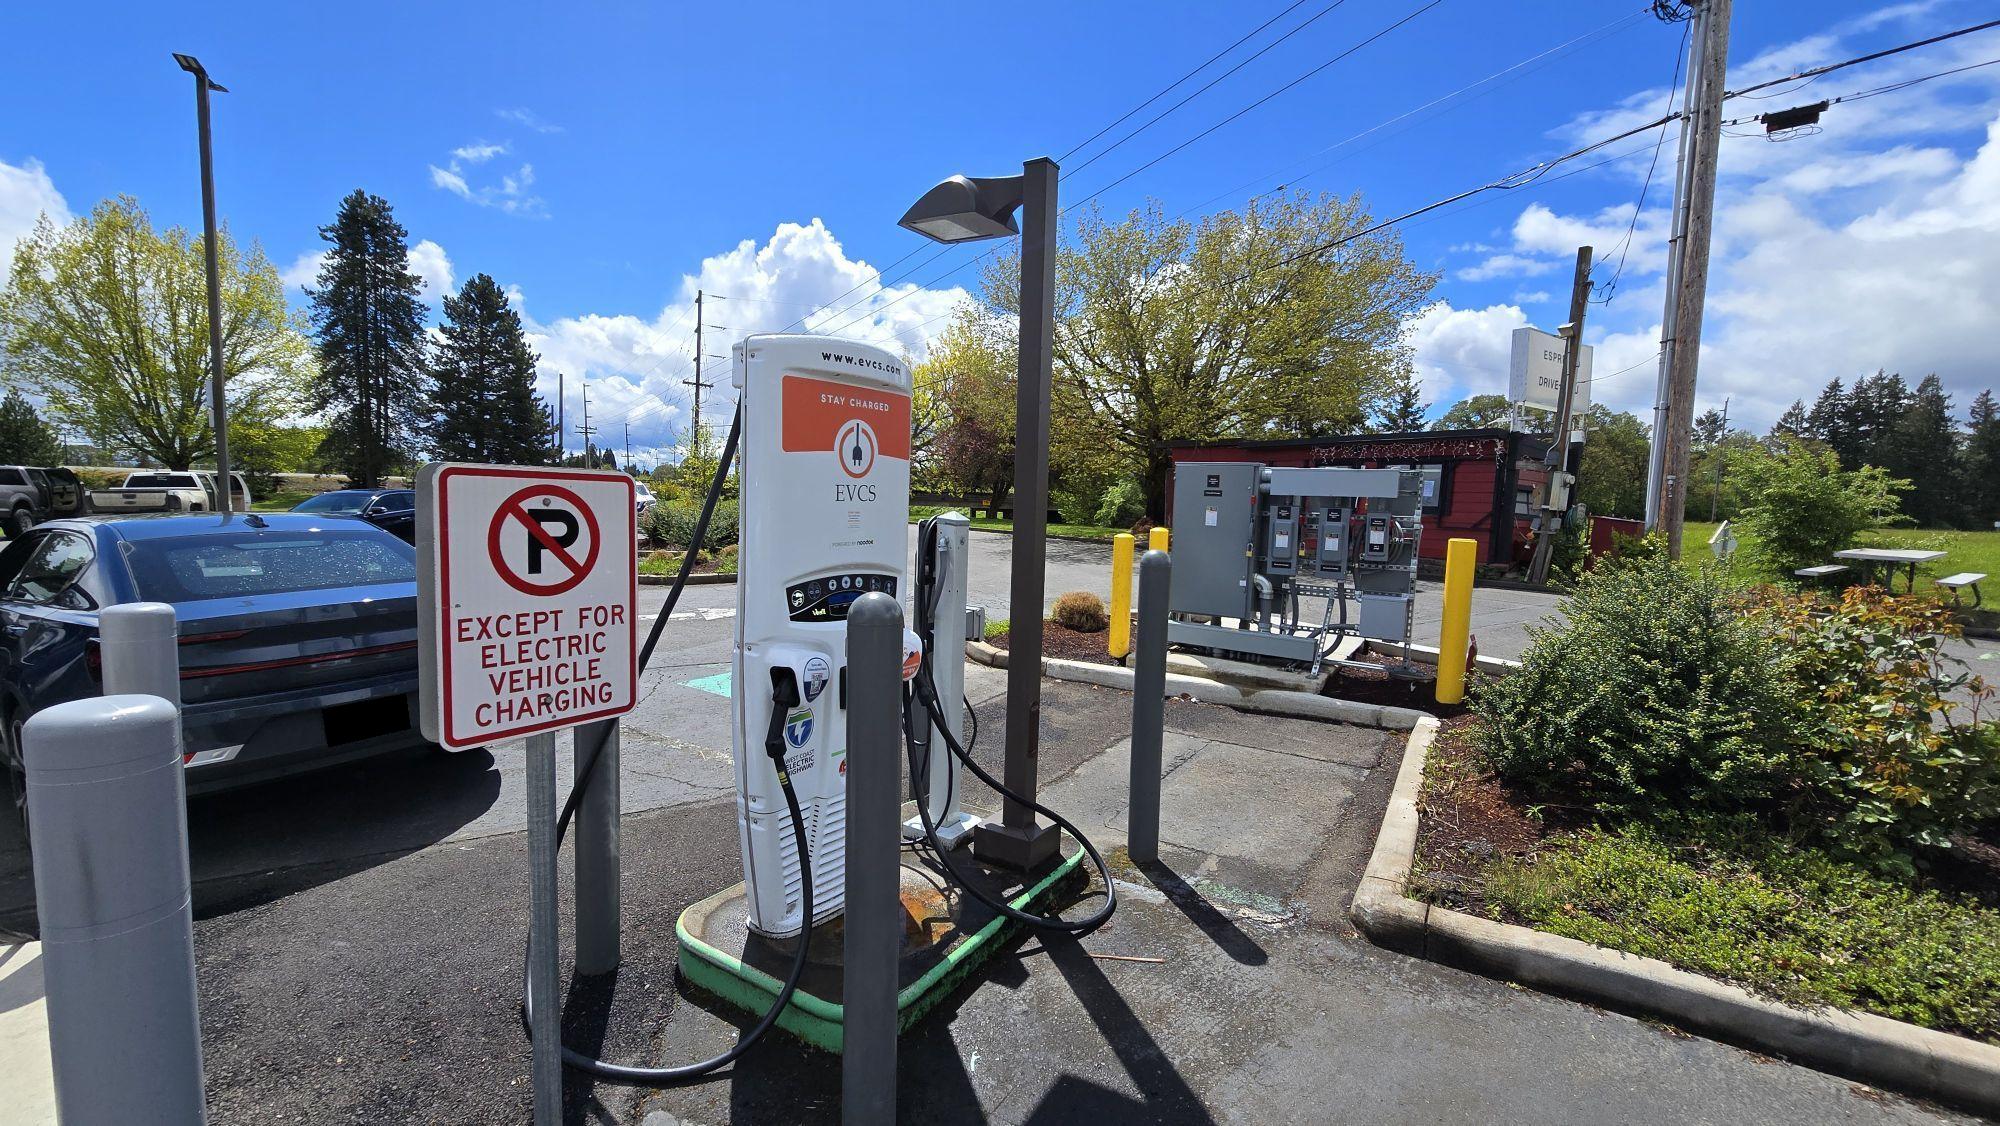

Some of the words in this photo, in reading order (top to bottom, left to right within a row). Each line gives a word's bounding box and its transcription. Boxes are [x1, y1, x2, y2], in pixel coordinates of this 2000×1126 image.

[821, 351, 901, 376] www.evcs.com
[1543, 350, 1562, 364] ESPR
[1538, 376, 1561, 390] DRIVE
[820, 393, 845, 406] STAY
[850, 398, 890, 412] CHARGED
[835, 484, 877, 503] EVCS
[457, 609, 564, 643] EXCEPT
[579, 604, 625, 629] FOR
[481, 631, 607, 669] ELECTRIC
[489, 658, 602, 696] VEHICLE
[475, 682, 613, 728] CHARGING
[786, 755, 815, 770] ELECTRIC
[800, 749, 815, 758] COAST
